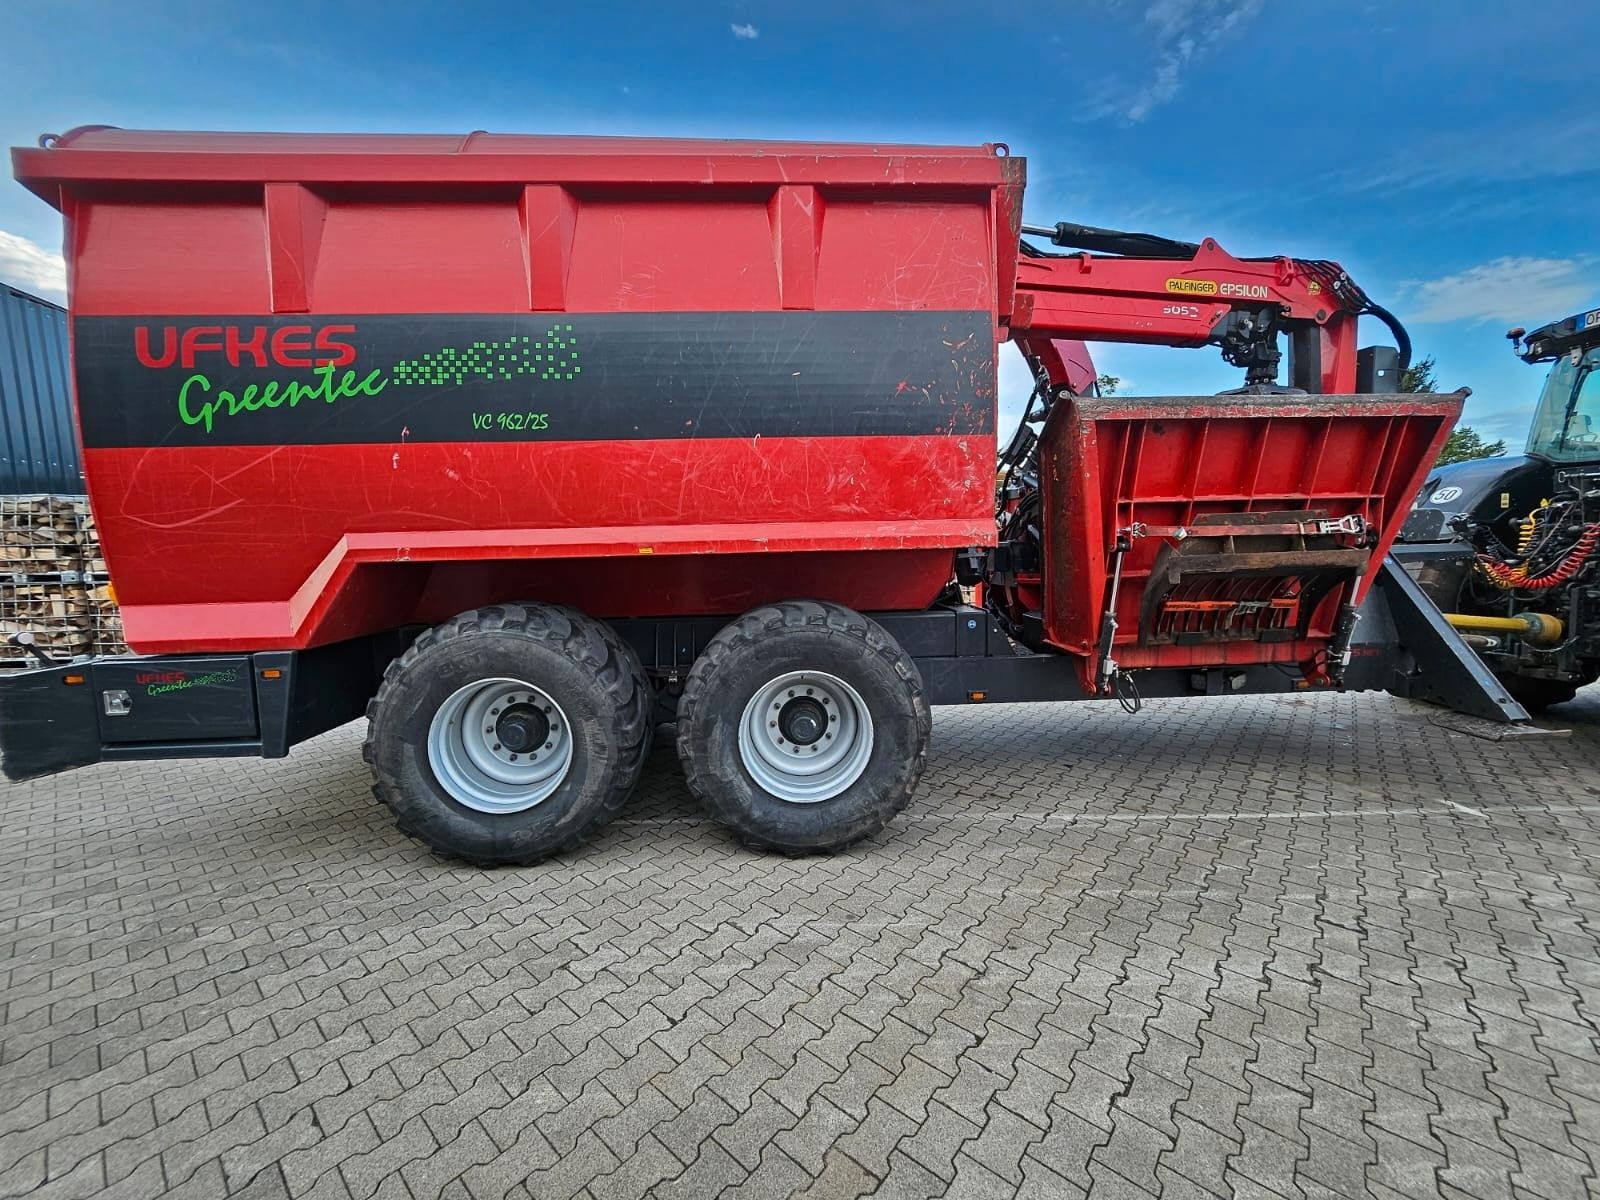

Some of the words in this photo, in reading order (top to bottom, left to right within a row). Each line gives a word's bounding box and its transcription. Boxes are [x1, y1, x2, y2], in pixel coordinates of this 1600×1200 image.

[1168, 280, 1215, 293] PALFINGER
[1219, 283, 1268, 299] EPSILON
[134, 324, 358, 369] UFKES
[177, 360, 389, 434] Greentec
[472, 412, 493, 430] VC
[496, 411, 549, 431] 962/25
[1434, 488, 1458, 501] 50
